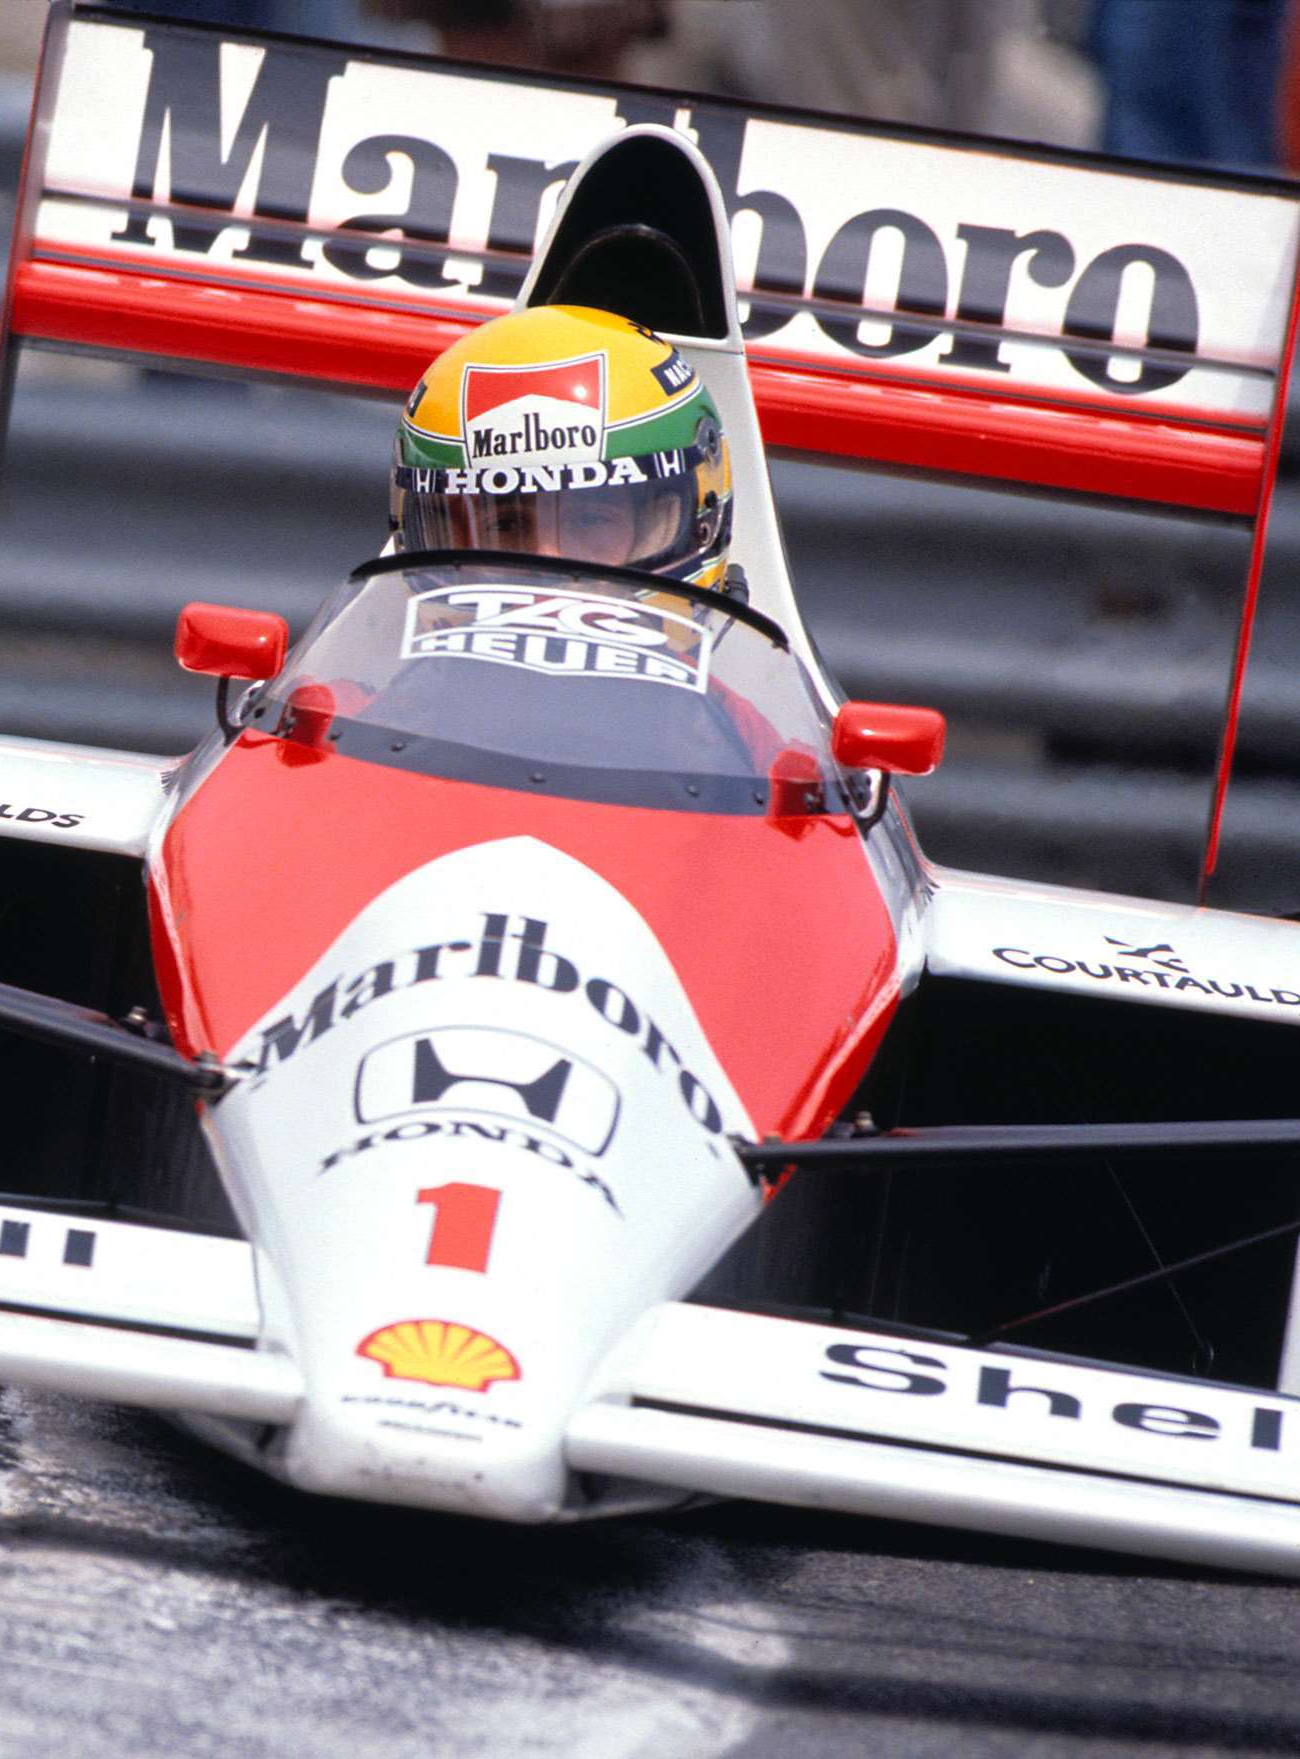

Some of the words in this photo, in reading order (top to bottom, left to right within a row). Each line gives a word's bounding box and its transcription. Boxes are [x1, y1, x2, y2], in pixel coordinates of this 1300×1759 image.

[111, 28, 1199, 394] Marboro
[444, 457, 648, 495] HONDA
[472, 412, 596, 459] Marlboro
[421, 632, 688, 683] HEUER
[448, 593, 668, 647] TAG
[251, 912, 723, 1136] Marlboro
[318, 1121, 625, 1220] HONDA
[416, 1181, 503, 1273] 1
[818, 1343, 1283, 1451] Shel
